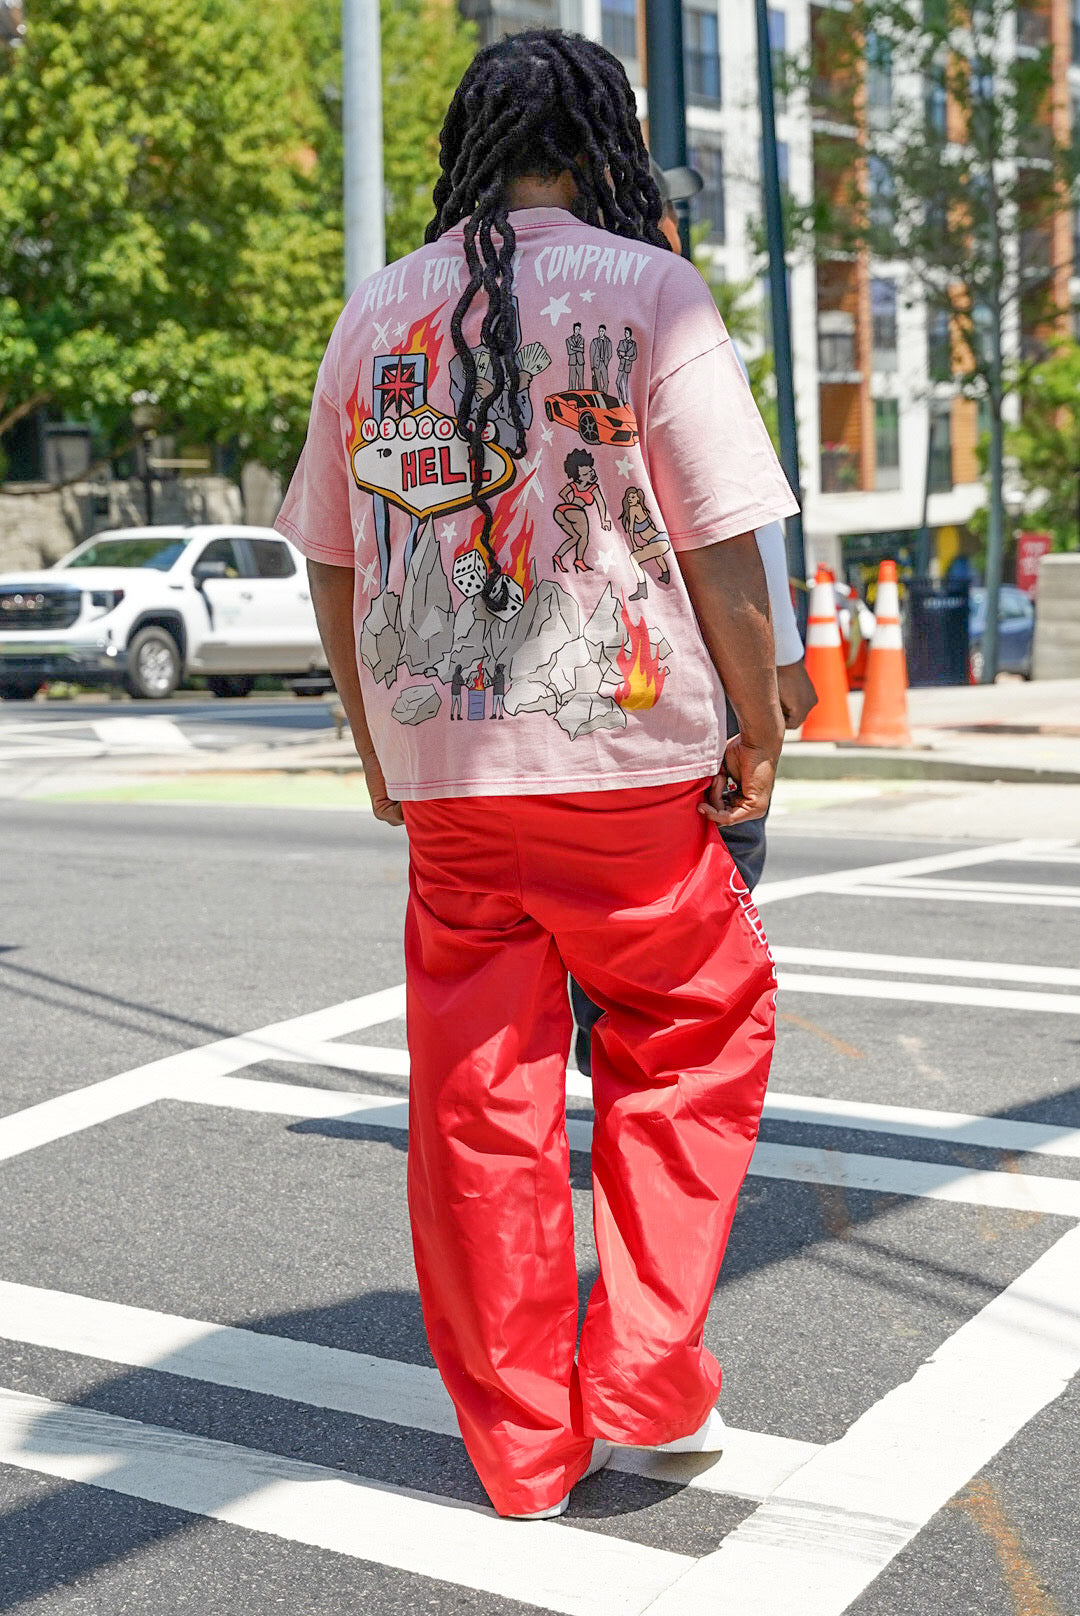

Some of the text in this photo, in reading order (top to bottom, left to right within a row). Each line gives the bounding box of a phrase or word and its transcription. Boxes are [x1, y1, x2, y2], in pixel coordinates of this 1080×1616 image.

[360, 264, 409, 314] HELL
[422, 256, 465, 301] FOR
[534, 244, 653, 288] COMPANY
[363, 419, 492, 441] WELCOE
